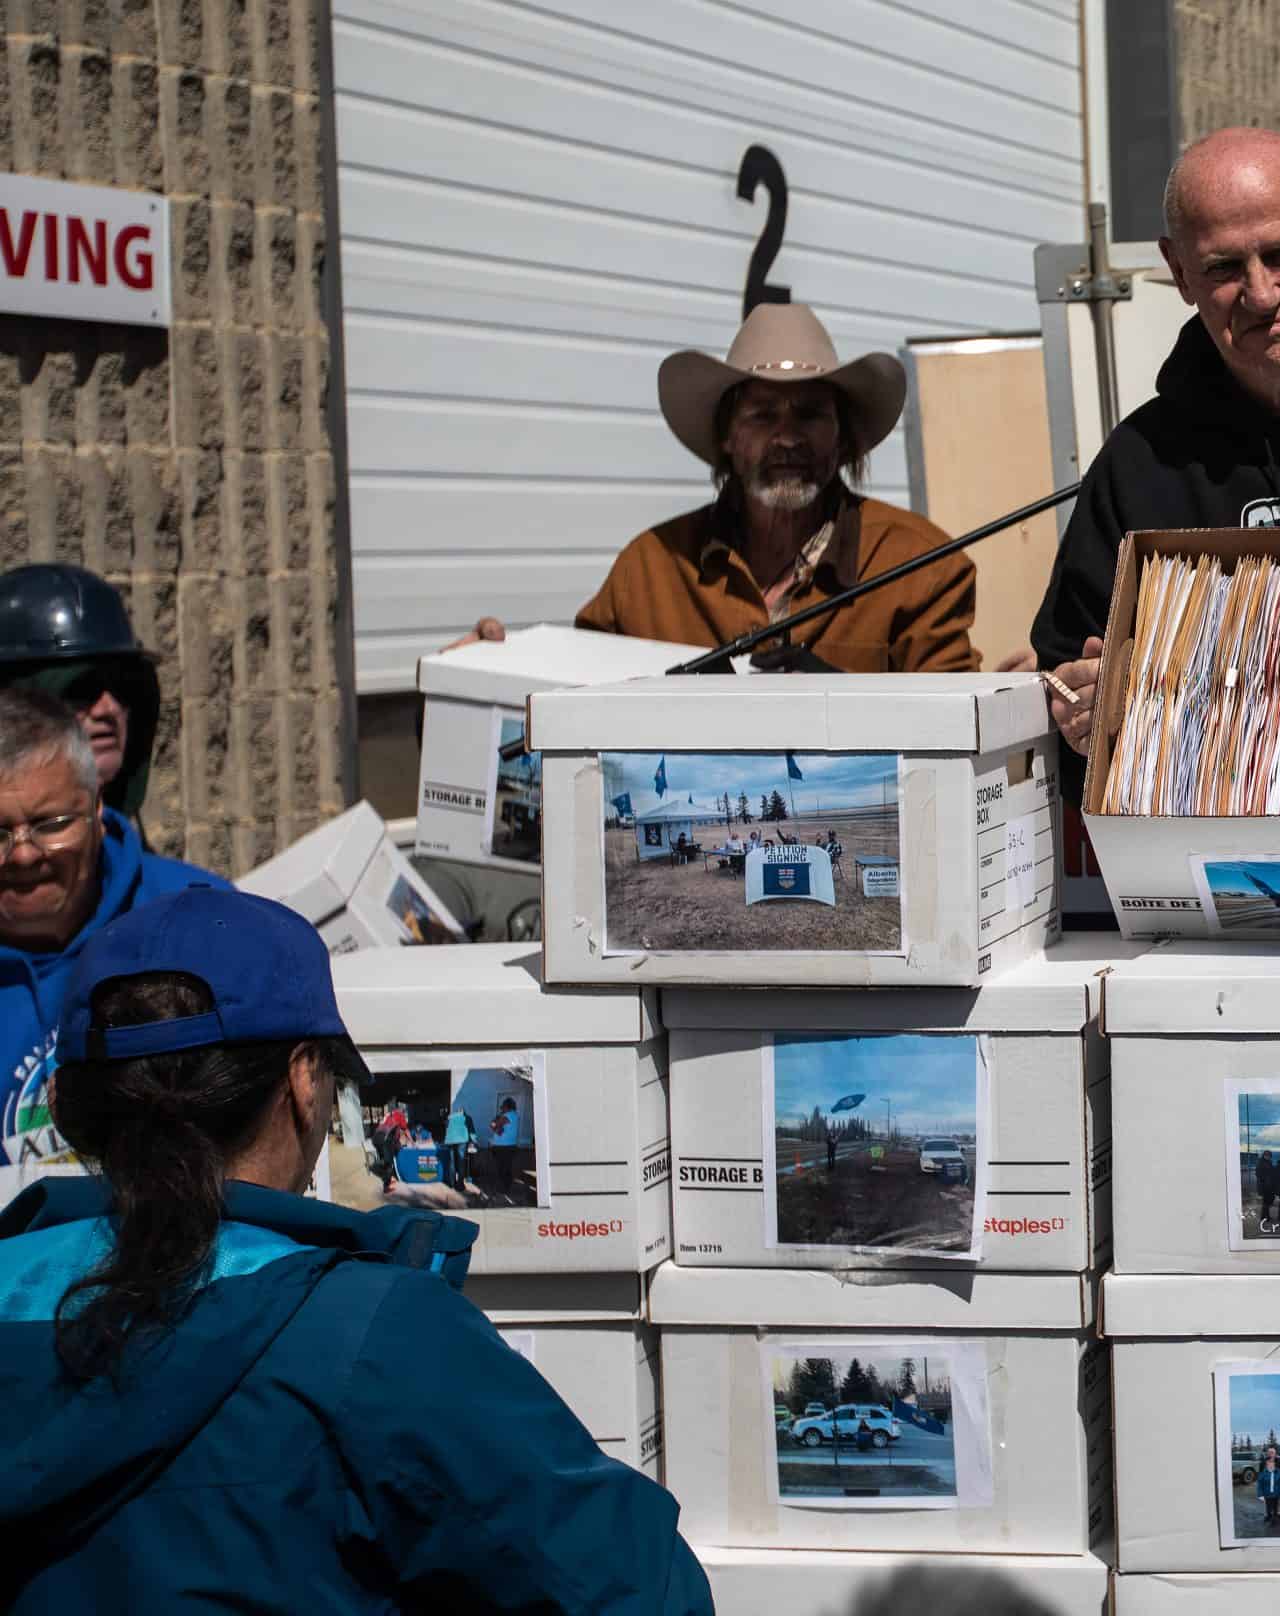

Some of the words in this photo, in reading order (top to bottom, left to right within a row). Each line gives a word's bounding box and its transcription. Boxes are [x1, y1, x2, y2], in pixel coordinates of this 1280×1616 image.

[737, 143, 791, 321] 2
[0, 207, 153, 293] VING
[424, 788, 472, 807] STORAGE
[977, 783, 1004, 806] STORAGE
[977, 807, 991, 825] BOX
[768, 855, 807, 863] SIGNING
[679, 1166, 748, 1182] STORAGE
[538, 1220, 609, 1239] staples
